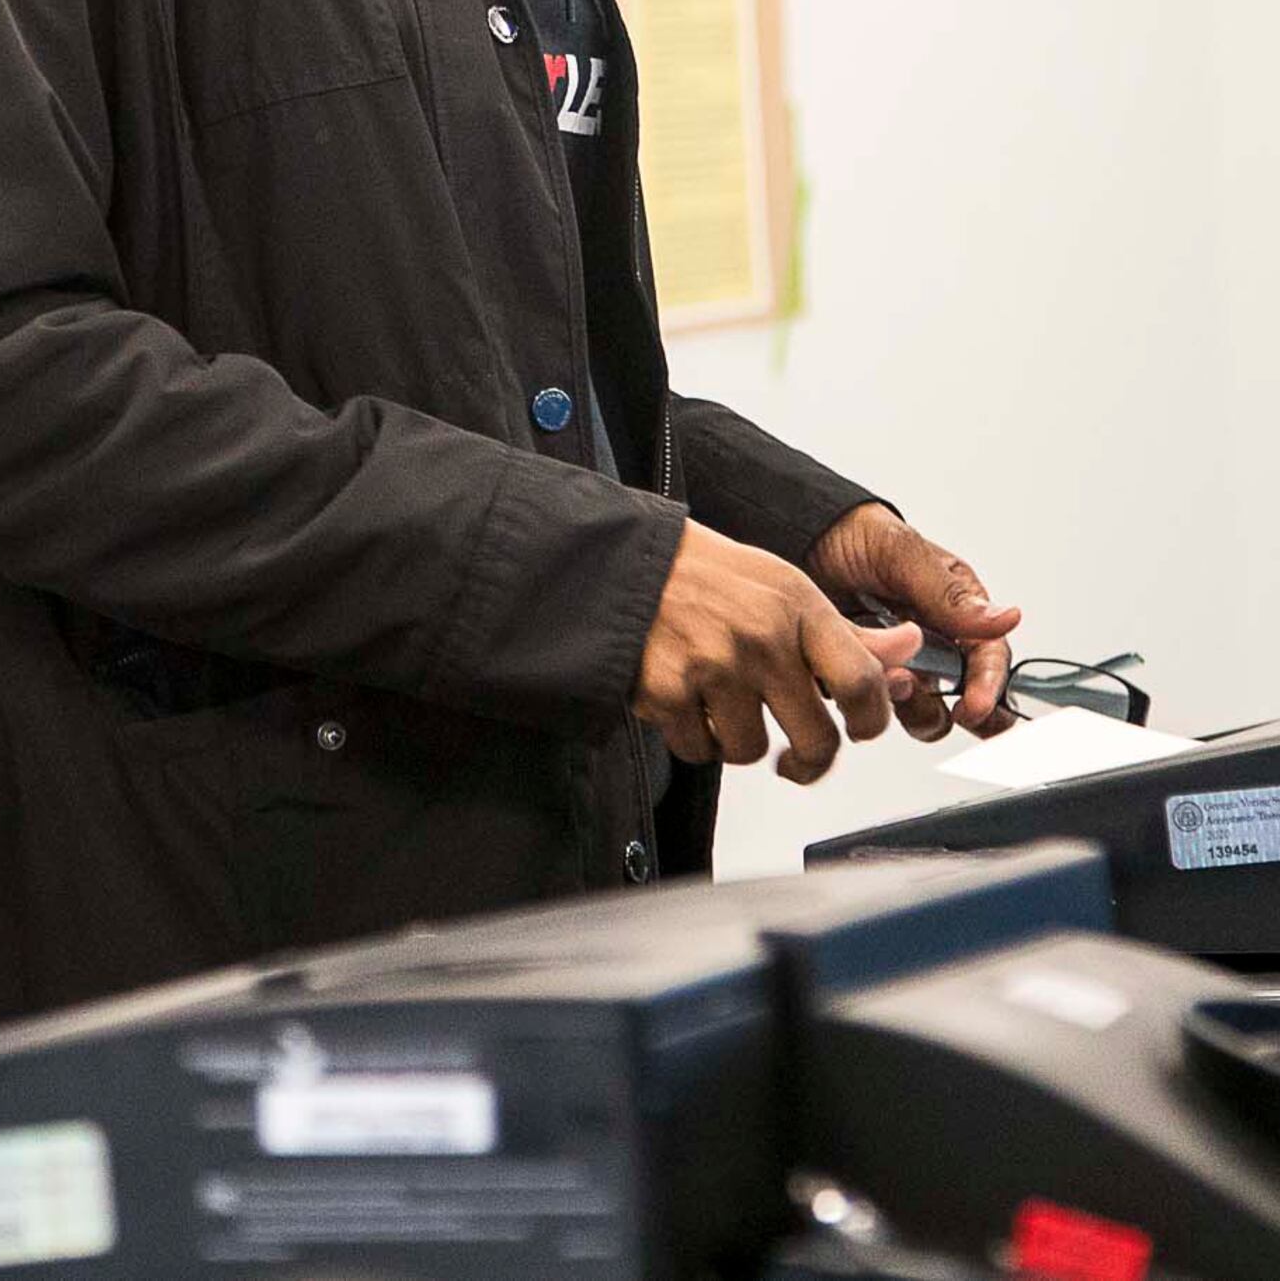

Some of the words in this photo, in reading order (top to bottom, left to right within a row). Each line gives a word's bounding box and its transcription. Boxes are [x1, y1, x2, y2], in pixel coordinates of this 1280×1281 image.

[1204, 801, 1238, 812] Georgia
[1240, 797, 1270, 808] Voting
[1208, 844, 1259, 859] 139454
